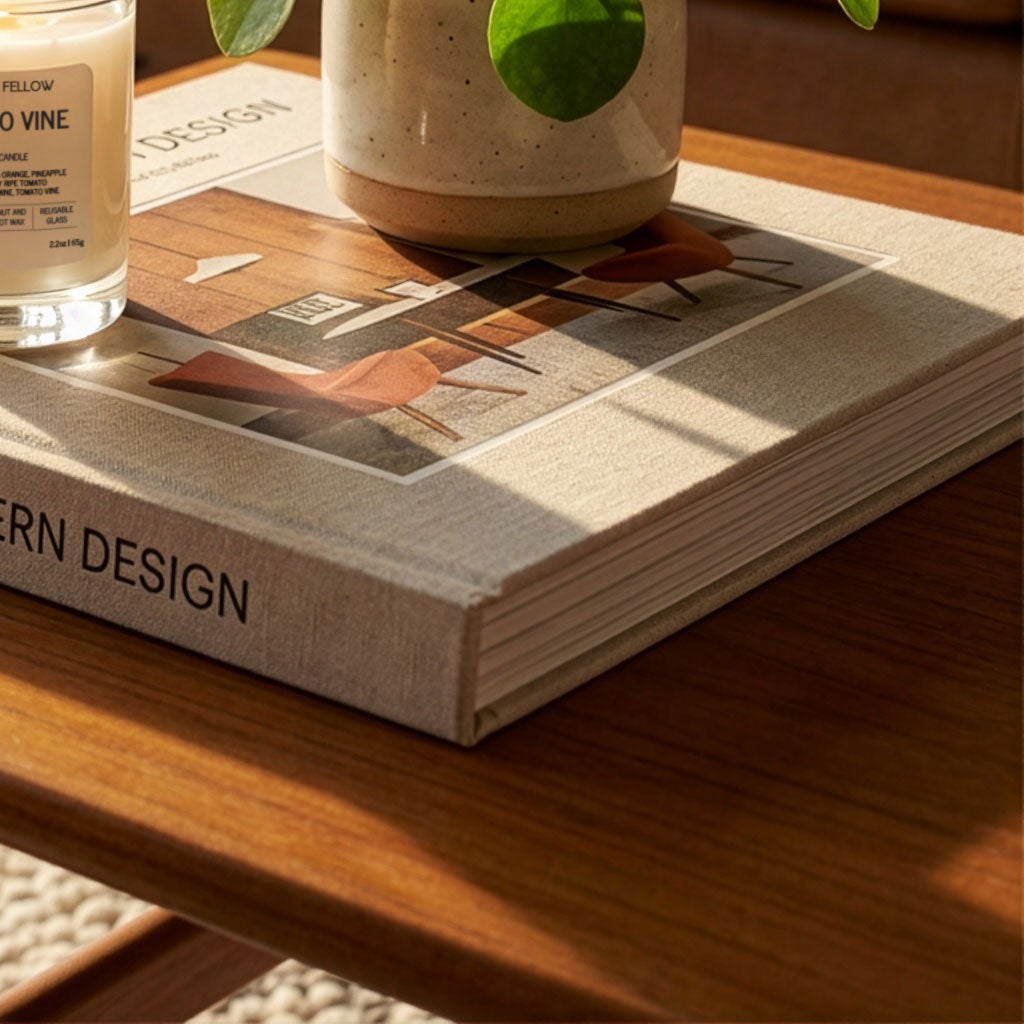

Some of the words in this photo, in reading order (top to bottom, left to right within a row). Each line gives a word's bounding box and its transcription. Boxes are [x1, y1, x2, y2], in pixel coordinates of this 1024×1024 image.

[2, 80, 54, 92] FELLOW
[21, 109, 69, 130] VINE
[136, 97, 293, 153] DESIGN
[31, 169, 67, 178] PINEAPPLE
[12, 208, 27, 216] AND
[40, 205, 74, 215] REUSABLE
[10, 218, 25, 226] WAX
[46, 216, 68, 224] GLASS
[81, 527, 250, 624] DESIGN
